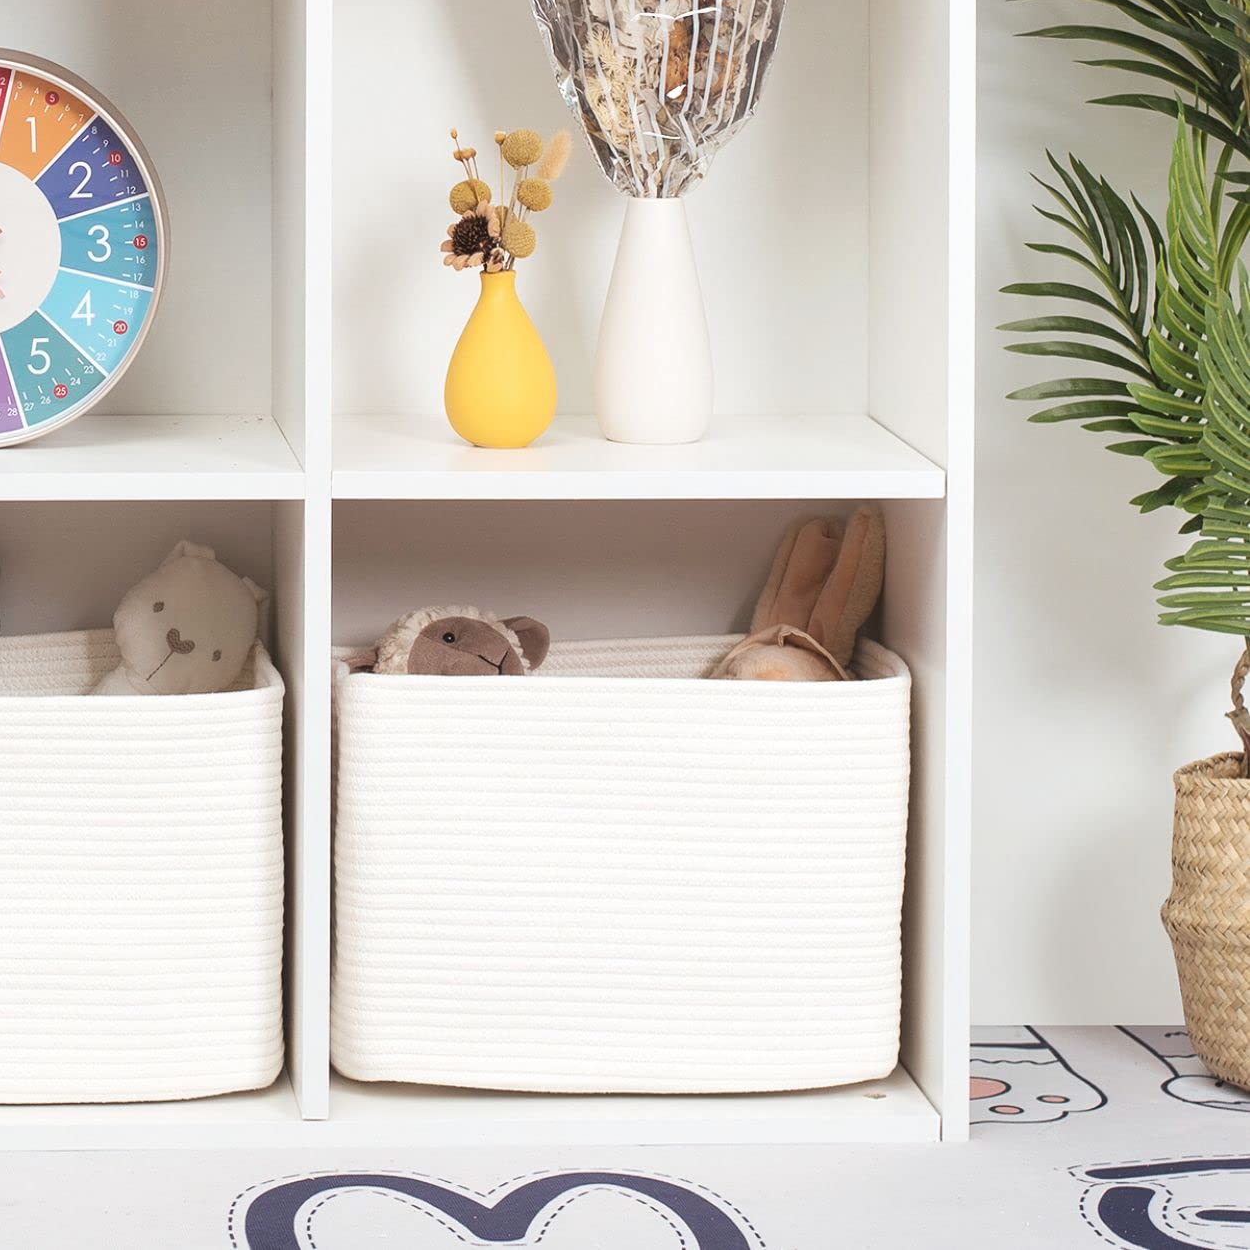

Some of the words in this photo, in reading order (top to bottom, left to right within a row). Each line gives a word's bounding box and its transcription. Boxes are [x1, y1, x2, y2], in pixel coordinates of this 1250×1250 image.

[0, 77, 6, 86] 2
[17, 81, 23, 89] 3
[49, 94, 55, 102] 5
[65, 104, 70, 112] 6
[79, 114, 84, 122] 7
[91, 126, 97, 134] 8
[25, 116, 37, 154] 1
[103, 139, 109, 148] 9
[111, 154, 121, 163] 10
[120, 169, 129, 177] 11
[68, 161, 94, 199] 2
[126, 186, 136, 194] 12
[131, 203, 141, 211] 13
[134, 221, 144, 229] 14
[87, 224, 112, 263] 3
[135, 237, 146, 246] 15
[136, 256, 145, 264] 16
[133, 273, 142, 281] 17
[129, 290, 139, 299] 18
[71, 289, 96, 327] 4
[124, 307, 134, 315] 19
[116, 323, 126, 332] 20
[107, 338, 117, 347] 21
[26, 337, 50, 375] 5
[95, 353, 106, 361] 22
[84, 365, 94, 374] 23
[70, 377, 81, 386] 24
[55, 387, 66, 396] 25
[40, 396, 51, 405] 26
[7, 407, 18, 416] 28
[24, 402, 34, 412] 27
